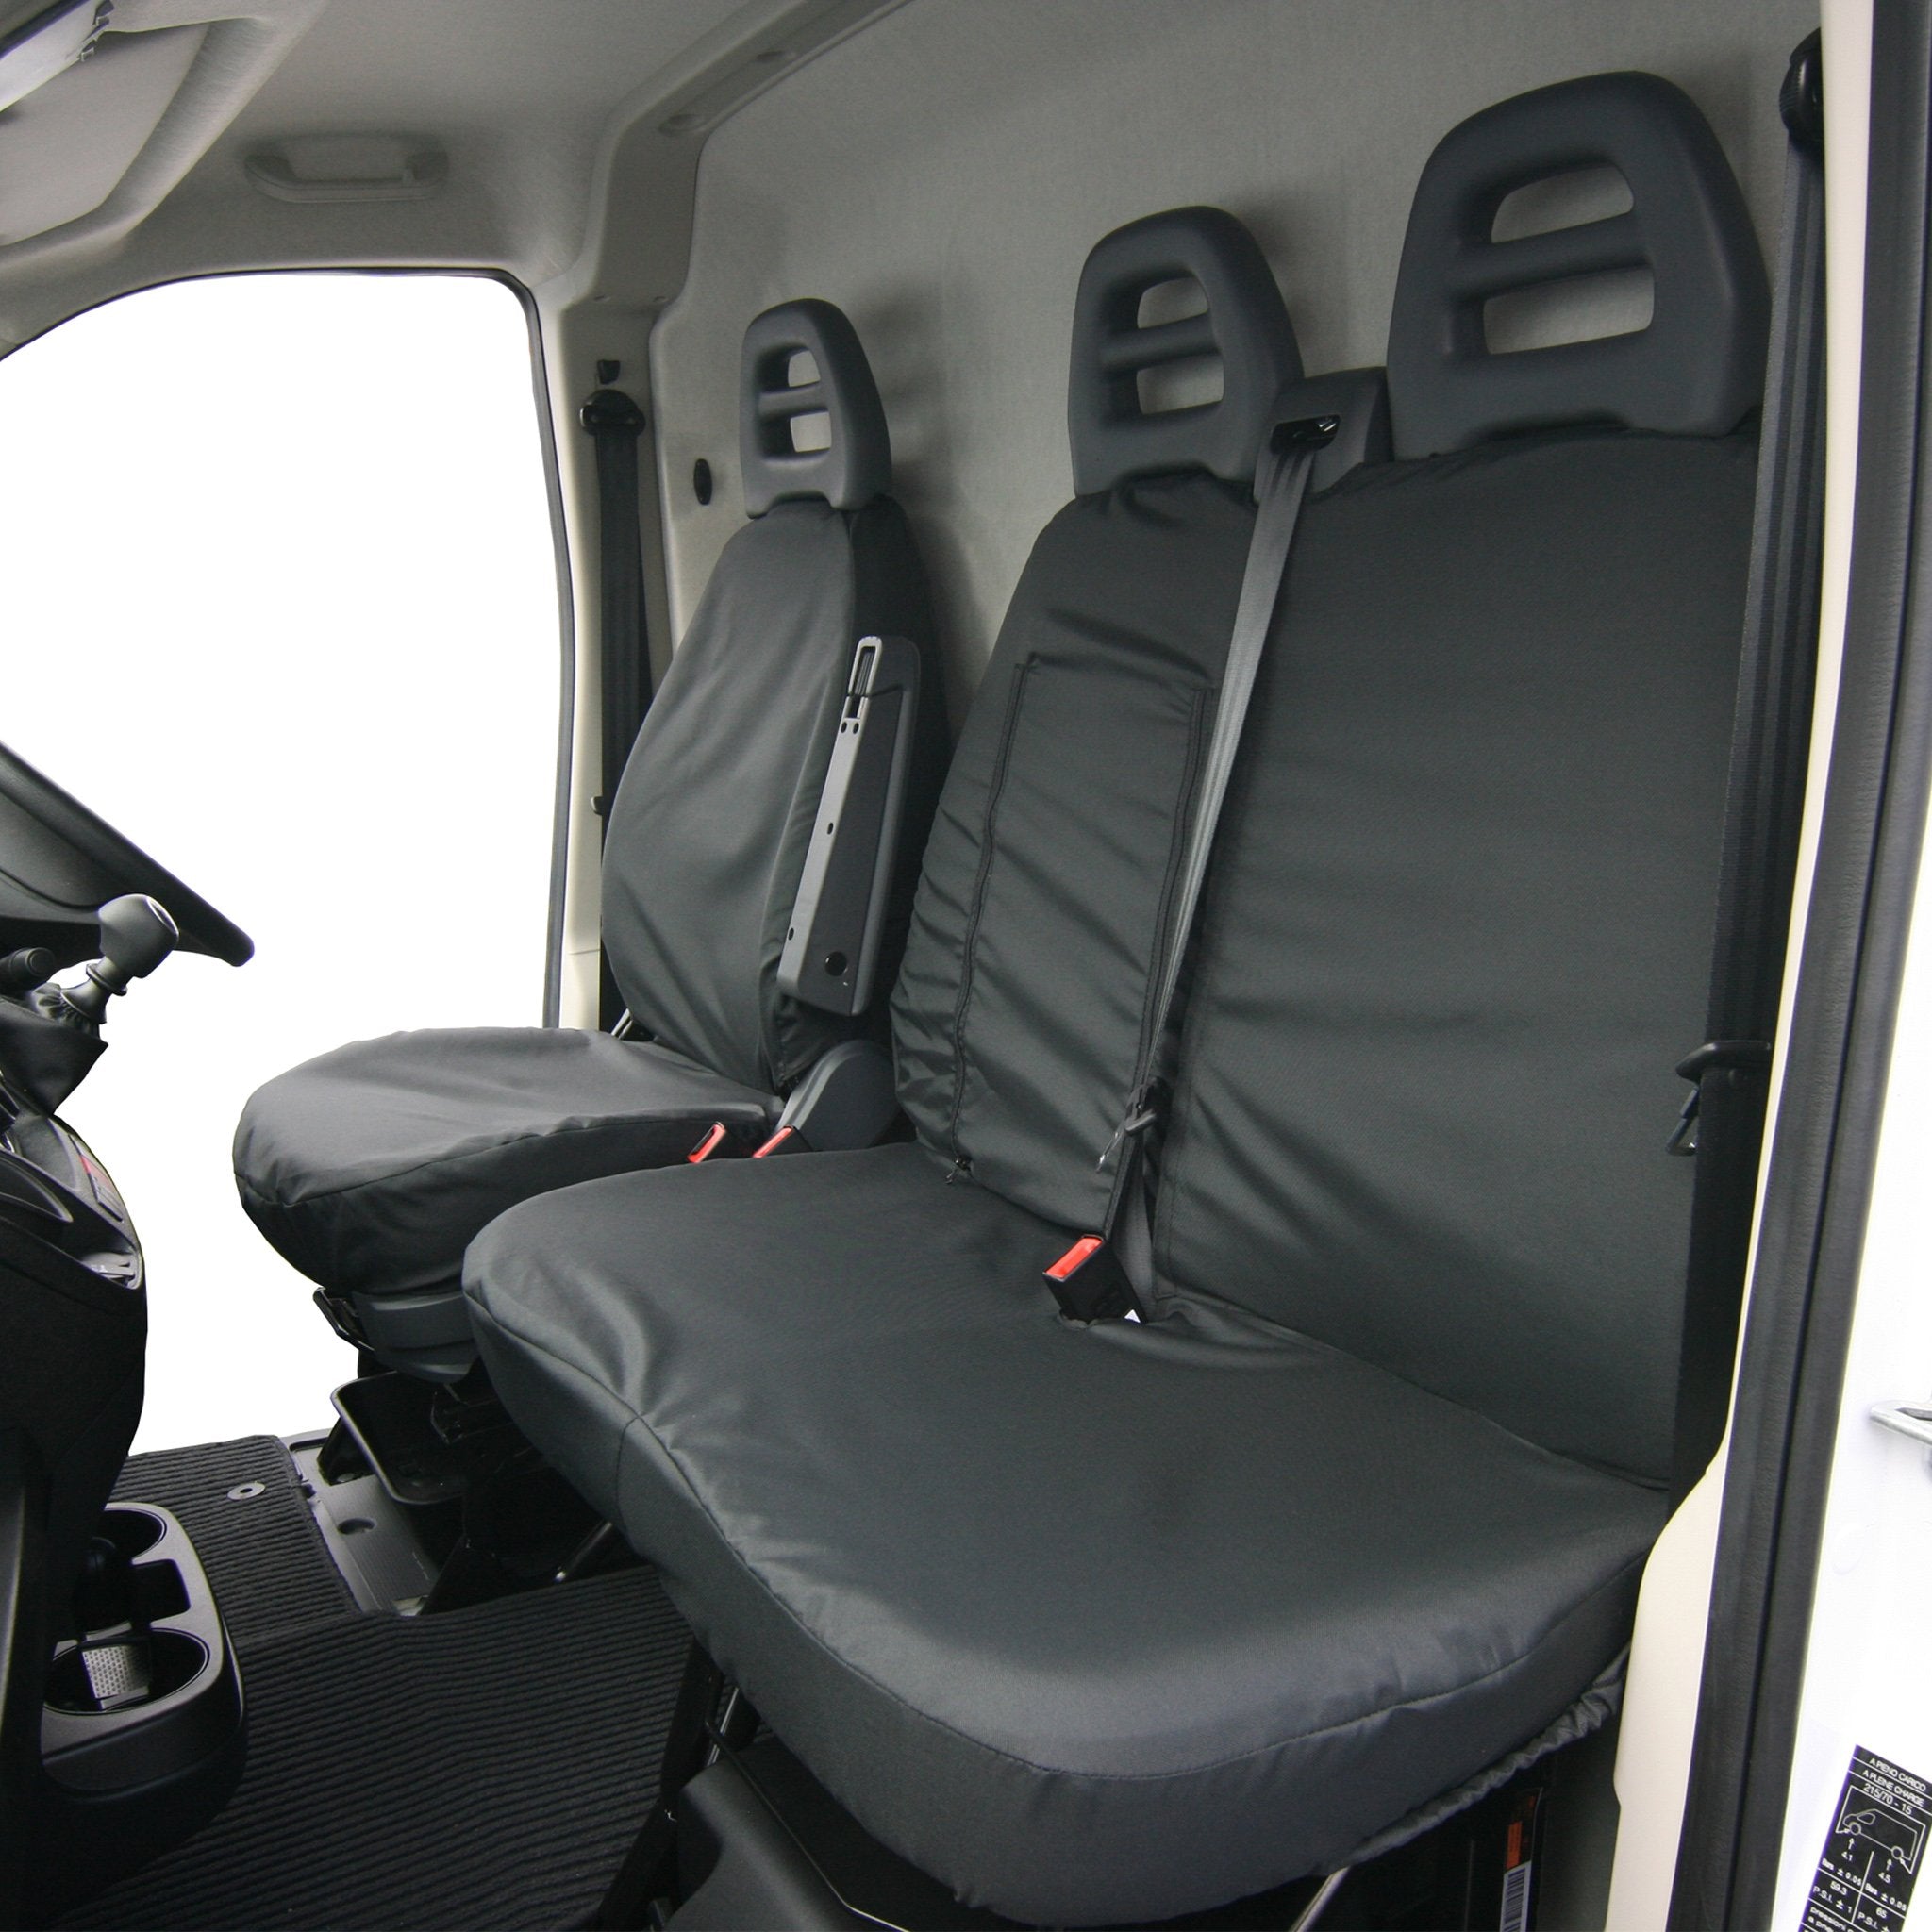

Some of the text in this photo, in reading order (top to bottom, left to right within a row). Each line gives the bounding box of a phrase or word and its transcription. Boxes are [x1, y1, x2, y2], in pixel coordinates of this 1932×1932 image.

[1898, 1773, 1927, 1792] CARICO
[1863, 1783, 1893, 1805] 215/70
[1901, 1803, 1913, 1815] 15
[1894, 1785, 1925, 1807] CHARGE
[1845, 1872, 1862, 1886] 0.05
[1890, 1897, 1907, 1911] 0.05
